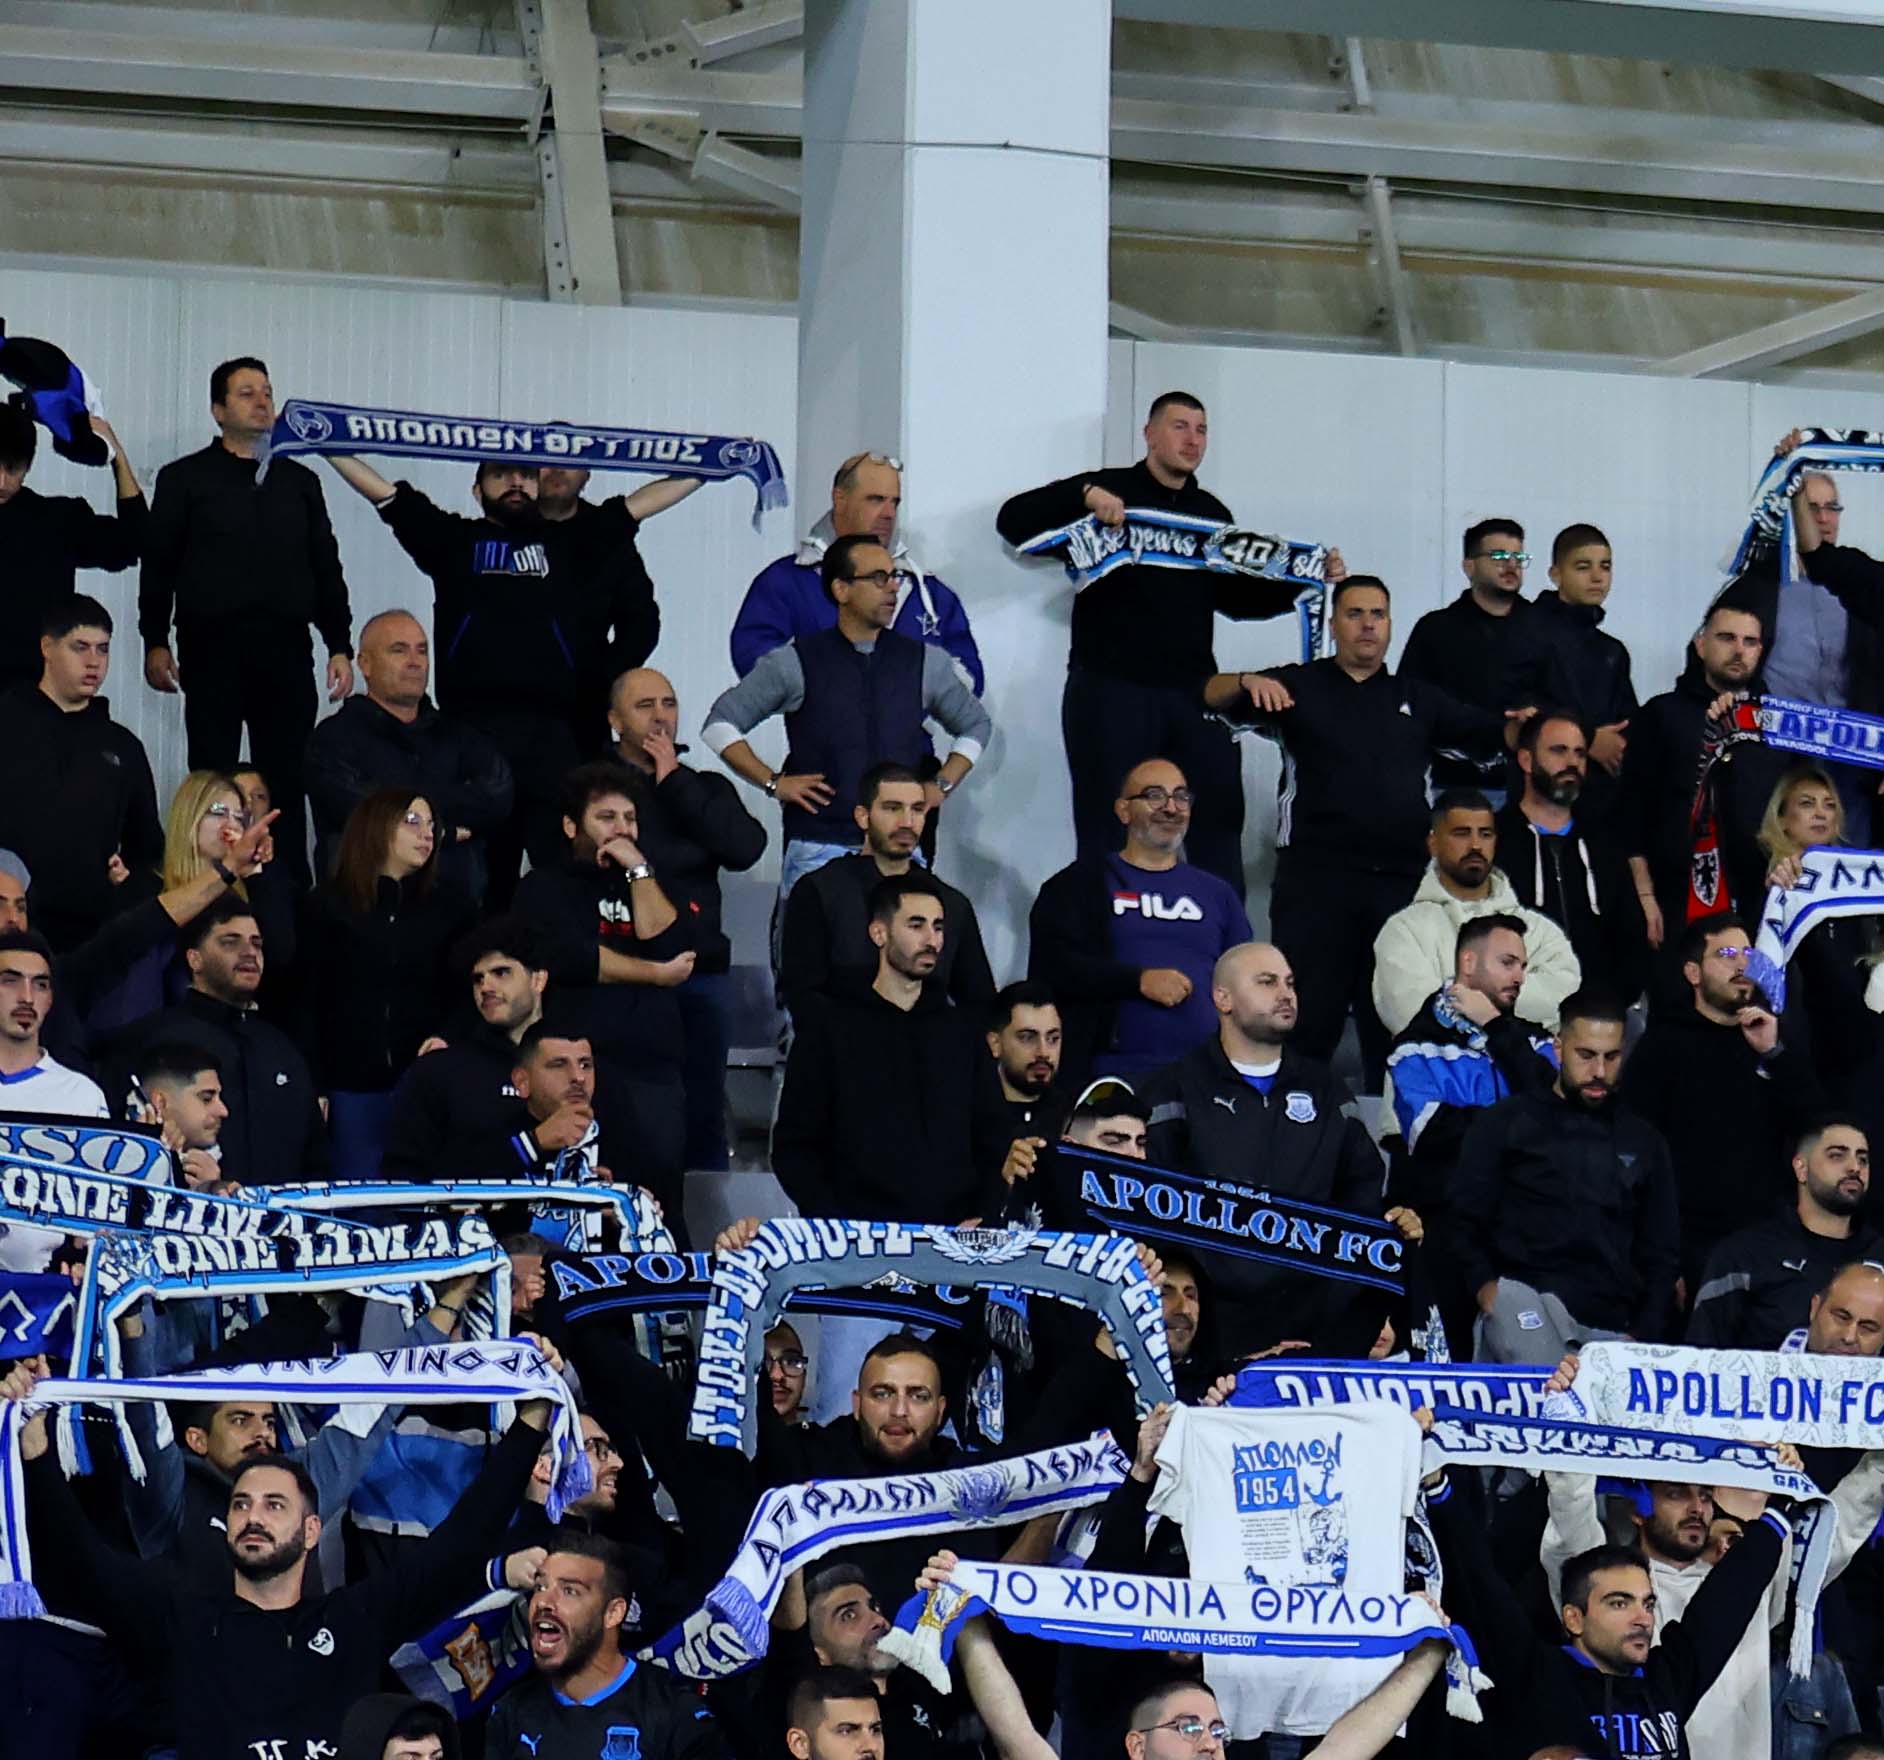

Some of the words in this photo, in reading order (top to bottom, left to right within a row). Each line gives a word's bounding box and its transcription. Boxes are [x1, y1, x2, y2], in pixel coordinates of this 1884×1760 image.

[1112, 890, 1204, 921] FILA
[1078, 1168, 1327, 1253] APOLLON
[1334, 1230, 1405, 1274] FC
[152, 1231, 280, 1276] ONE
[1628, 1367, 1824, 1426] APOLLON
[1239, 1475, 1298, 1508] 1954
[976, 1567, 1037, 1606] 70
[1061, 1574, 1228, 1621] ΧΡΟΝΙΑ
[1251, 1585, 1413, 1627] ΘΡΥΛΟΥ
[1141, 1629, 1201, 1646] ΑΠΟΛΛΩΝ
[1203, 1632, 1259, 1648] ΛΕΜΕΣΟΥ
